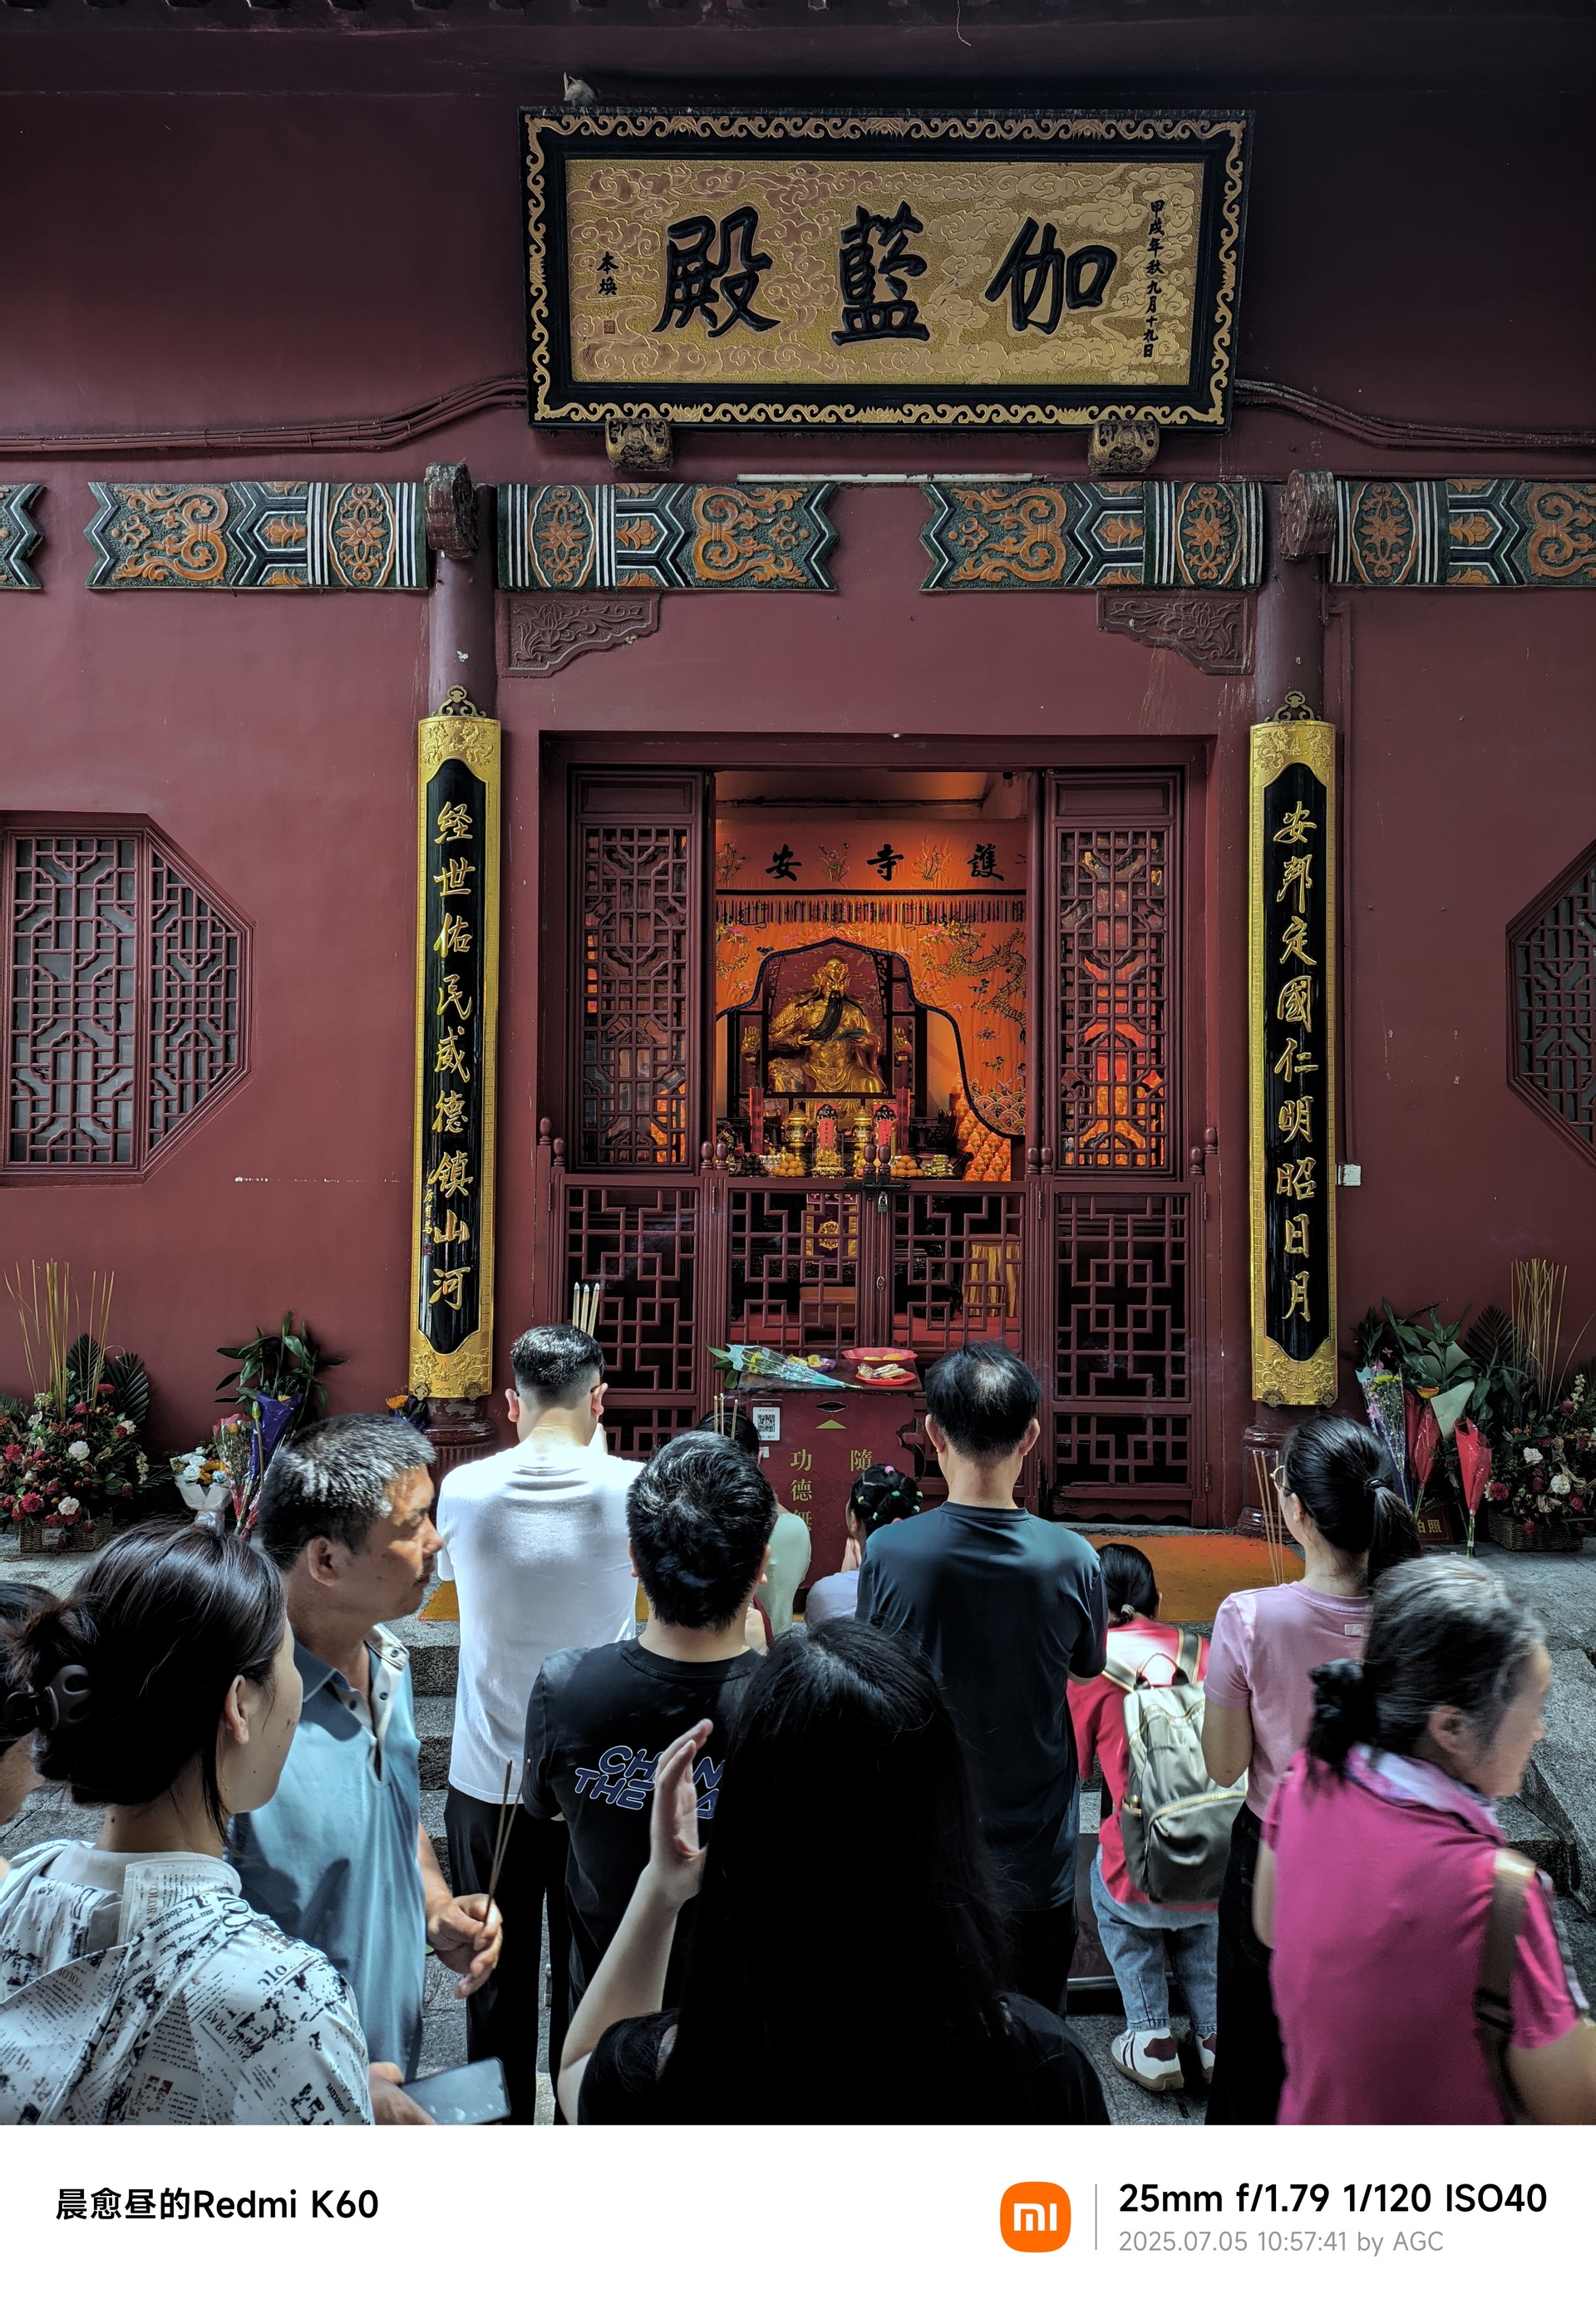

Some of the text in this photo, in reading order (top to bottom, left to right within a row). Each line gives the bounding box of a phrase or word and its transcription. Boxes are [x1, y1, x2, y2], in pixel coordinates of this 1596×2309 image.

[651, 200, 1118, 347] 伽藍殿
[575, 1768, 655, 1810] THE
